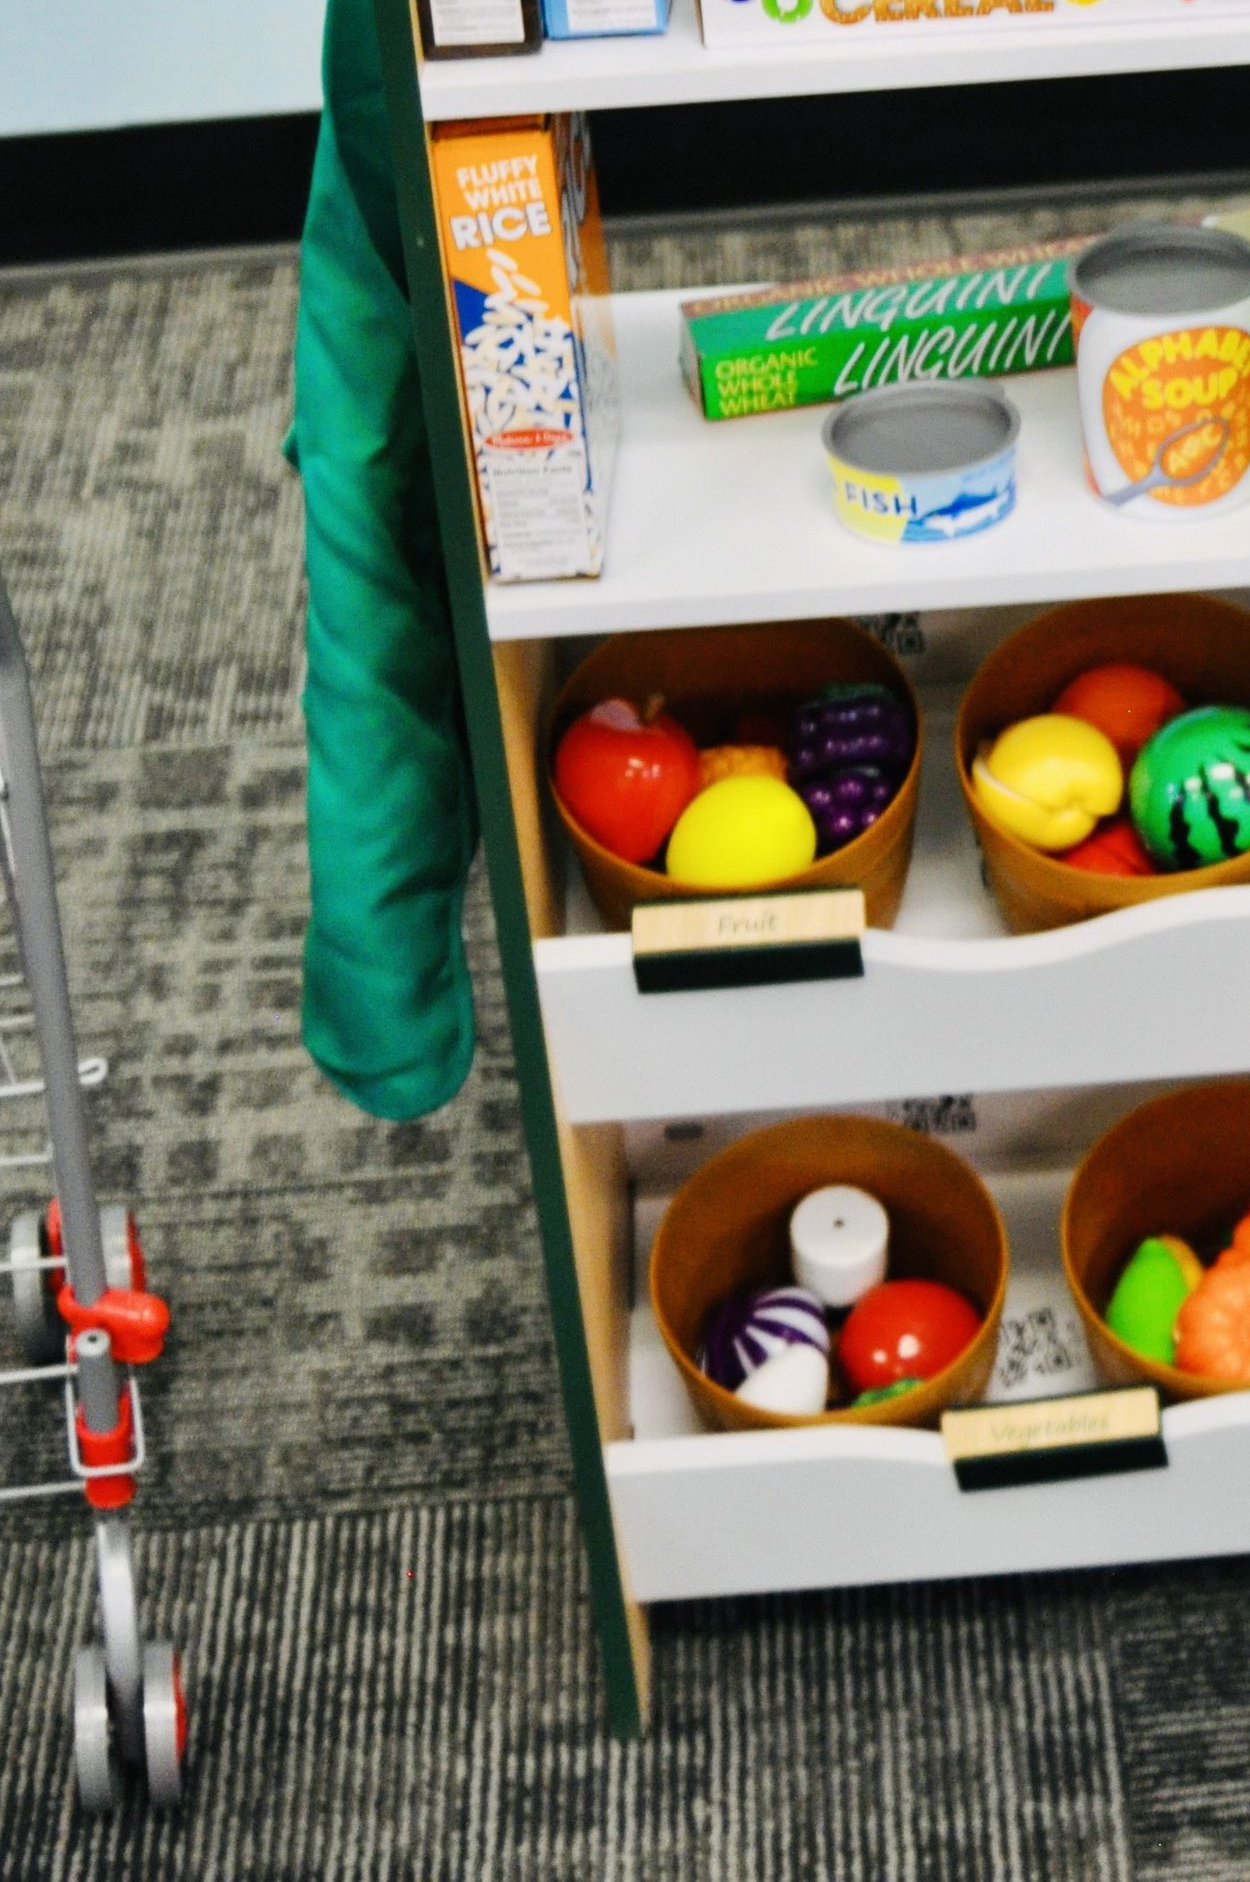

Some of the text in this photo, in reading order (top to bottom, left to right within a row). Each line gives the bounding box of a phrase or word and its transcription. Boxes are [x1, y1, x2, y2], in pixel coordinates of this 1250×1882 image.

[456, 154, 539, 191] FLUFFY
[463, 181, 543, 212] WHITE
[450, 201, 551, 251] RICE
[766, 263, 1053, 340] LINGUINI
[715, 346, 818, 379] ORGANIC
[834, 309, 1072, 395] LINGUINI
[717, 370, 796, 397] WHOLE
[1142, 369, 1238, 410] SOUP
[719, 388, 796, 417] WHEAT
[844, 483, 919, 515] FISH
